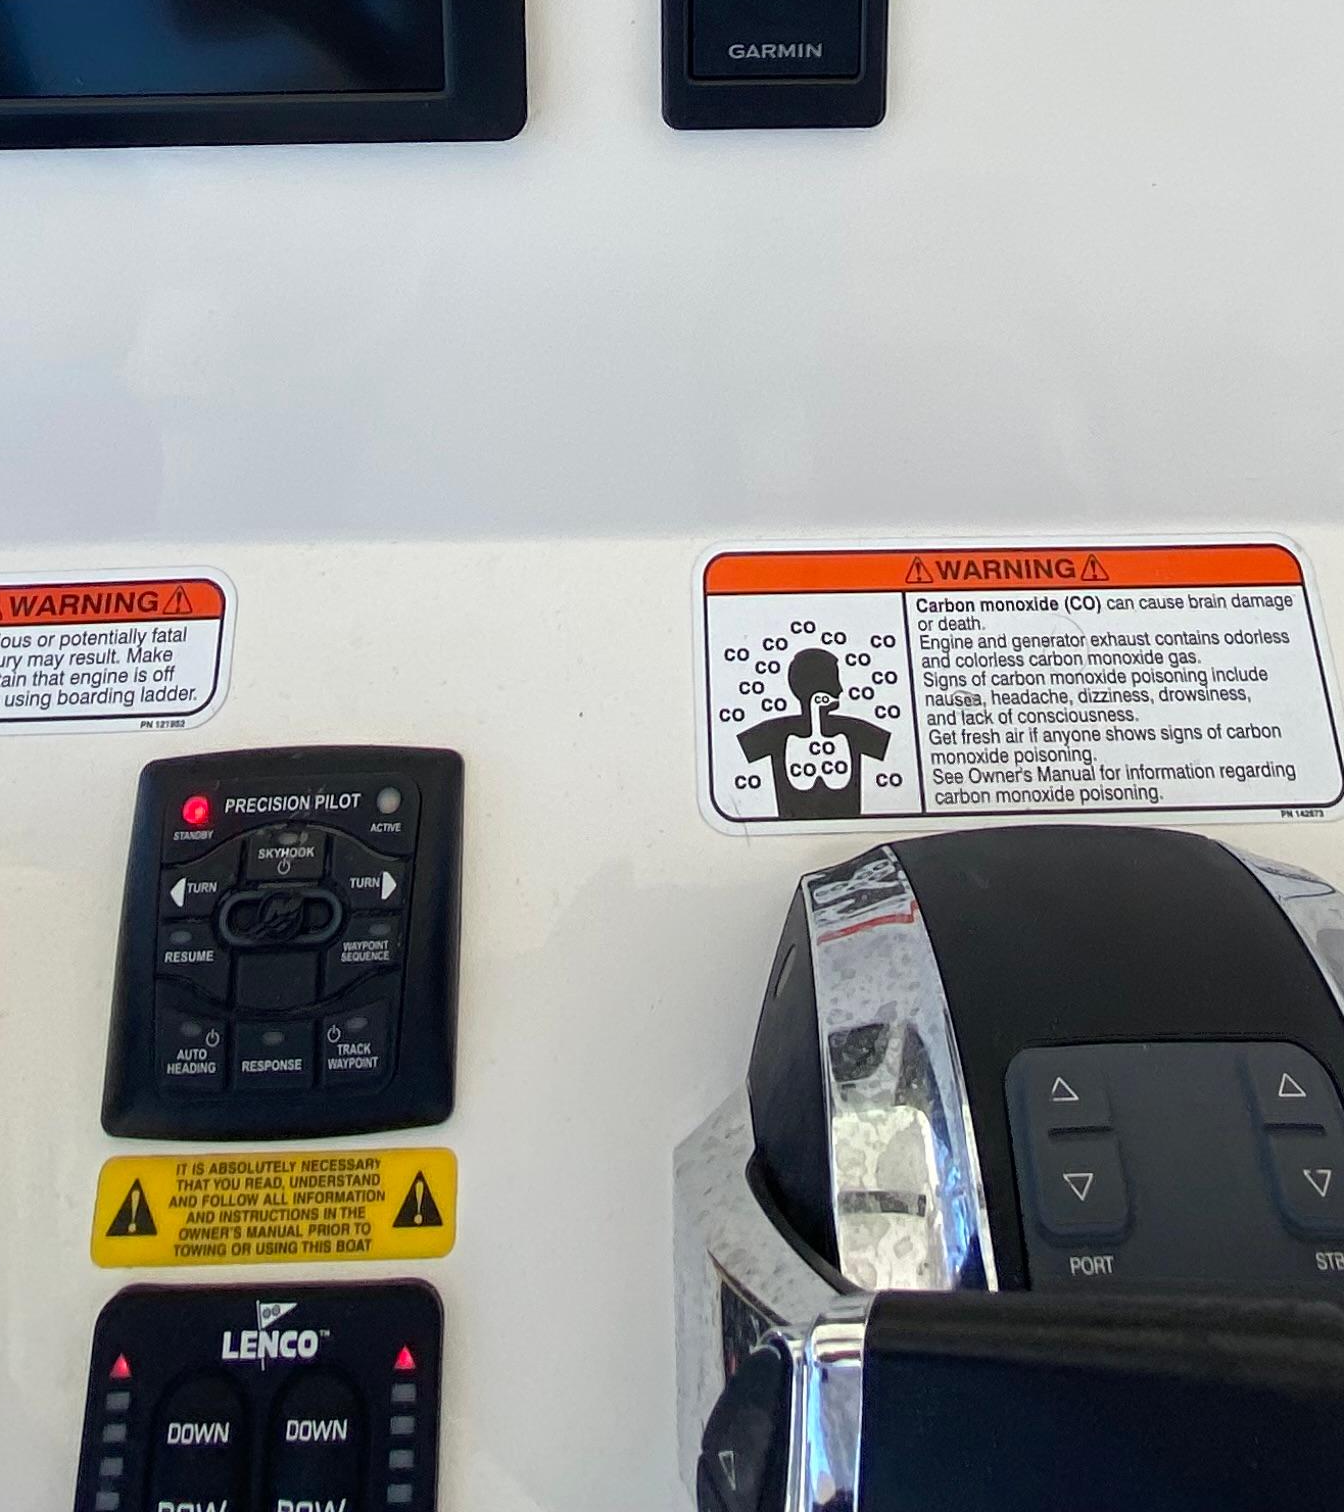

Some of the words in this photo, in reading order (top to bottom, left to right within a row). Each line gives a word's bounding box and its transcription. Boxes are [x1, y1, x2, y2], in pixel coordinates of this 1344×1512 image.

[727, 42, 823, 60] GARMIN
[935, 558, 1076, 580] WARNING
[9, 590, 159, 617] WARNING
[916, 598, 975, 613] Carbon
[981, 596, 1059, 612] monoxide
[1064, 595, 1102, 613] (CO)
[1107, 598, 1135, 610] can
[1139, 596, 1184, 610] cause
[1188, 594, 1227, 609] brain
[1231, 593, 1293, 611] damage
[918, 619, 933, 631] or
[938, 616, 985, 631] death.
[38, 635, 55, 648] or
[59, 628, 147, 650] potentially
[152, 627, 187, 643] fatal
[920, 634, 973, 652] Engine
[978, 633, 1006, 648] and
[1012, 633, 1086, 651] generator
[1090, 631, 1150, 647] exhaust
[1155, 630, 1220, 645] contains
[1224, 629, 1290, 644] odorless
[27, 653, 64, 670] may
[69, 648, 120, 665] result.
[127, 648, 173, 664] Make
[32, 670, 64, 686] that
[70, 670, 128, 688] engine
[134, 667, 147, 683] is
[153, 666, 174, 682] off
[5, 691, 52, 710] using
[57, 689, 135, 706] boarding
[140, 686, 197, 702] ladder.
[224, 795, 309, 814] PRECISION
[314, 793, 361, 810] PILOT
[173, 830, 214, 841] STANDBY
[370, 823, 401, 833] ACTIVE
[258, 846, 314, 860] SKYHOOK
[187, 882, 217, 893] TURN
[350, 877, 380, 888] TURN
[343, 940, 388, 951] WAYPOINT
[164, 951, 214, 963] RESUME
[341, 951, 390, 962] SEQUENCE
[177, 1049, 207, 1061] AUTO
[337, 1043, 371, 1055] TRACK
[167, 1061, 216, 1074] HEADING
[242, 1059, 302, 1072] RESPONSE
[327, 1056, 378, 1070] WAYPOINT
[176, 1163, 187, 1176] IT
[192, 1162, 204, 1175] IS
[208, 1160, 297, 1175] ABSOLUTELY
[301, 1159, 381, 1171] NECESSARY
[1069, 1255, 1114, 1276] PORT
[222, 1330, 319, 1360] LENCO
[167, 1422, 229, 1445] DOWN
[285, 1419, 348, 1441] DOWN
